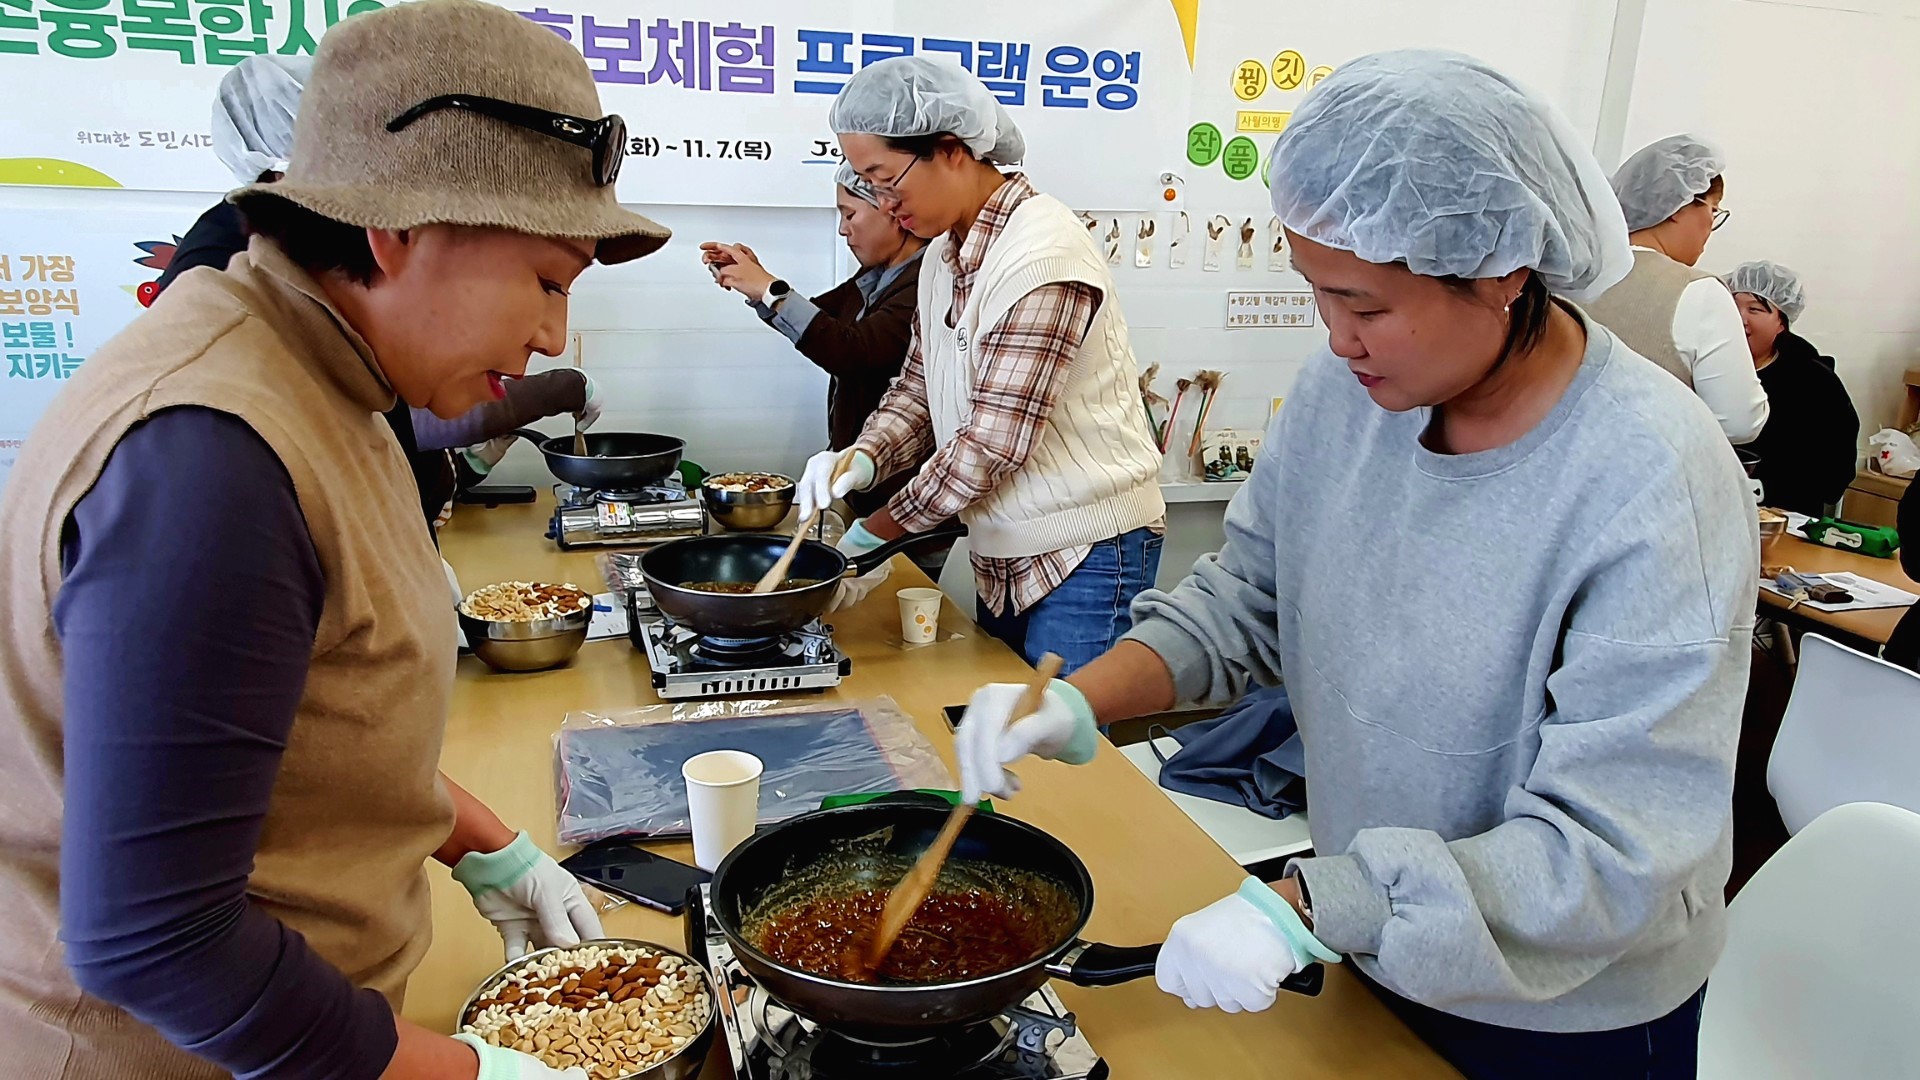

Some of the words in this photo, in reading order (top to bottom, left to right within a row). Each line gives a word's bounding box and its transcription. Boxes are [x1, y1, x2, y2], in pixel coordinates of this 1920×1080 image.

[1041, 45, 1141, 111] 운영
[77, 131, 130, 148] 위대한
[19, 254, 76, 283] 가장
[1282, 313, 1305, 324] 만들기
[1, 321, 58, 348] 보물
